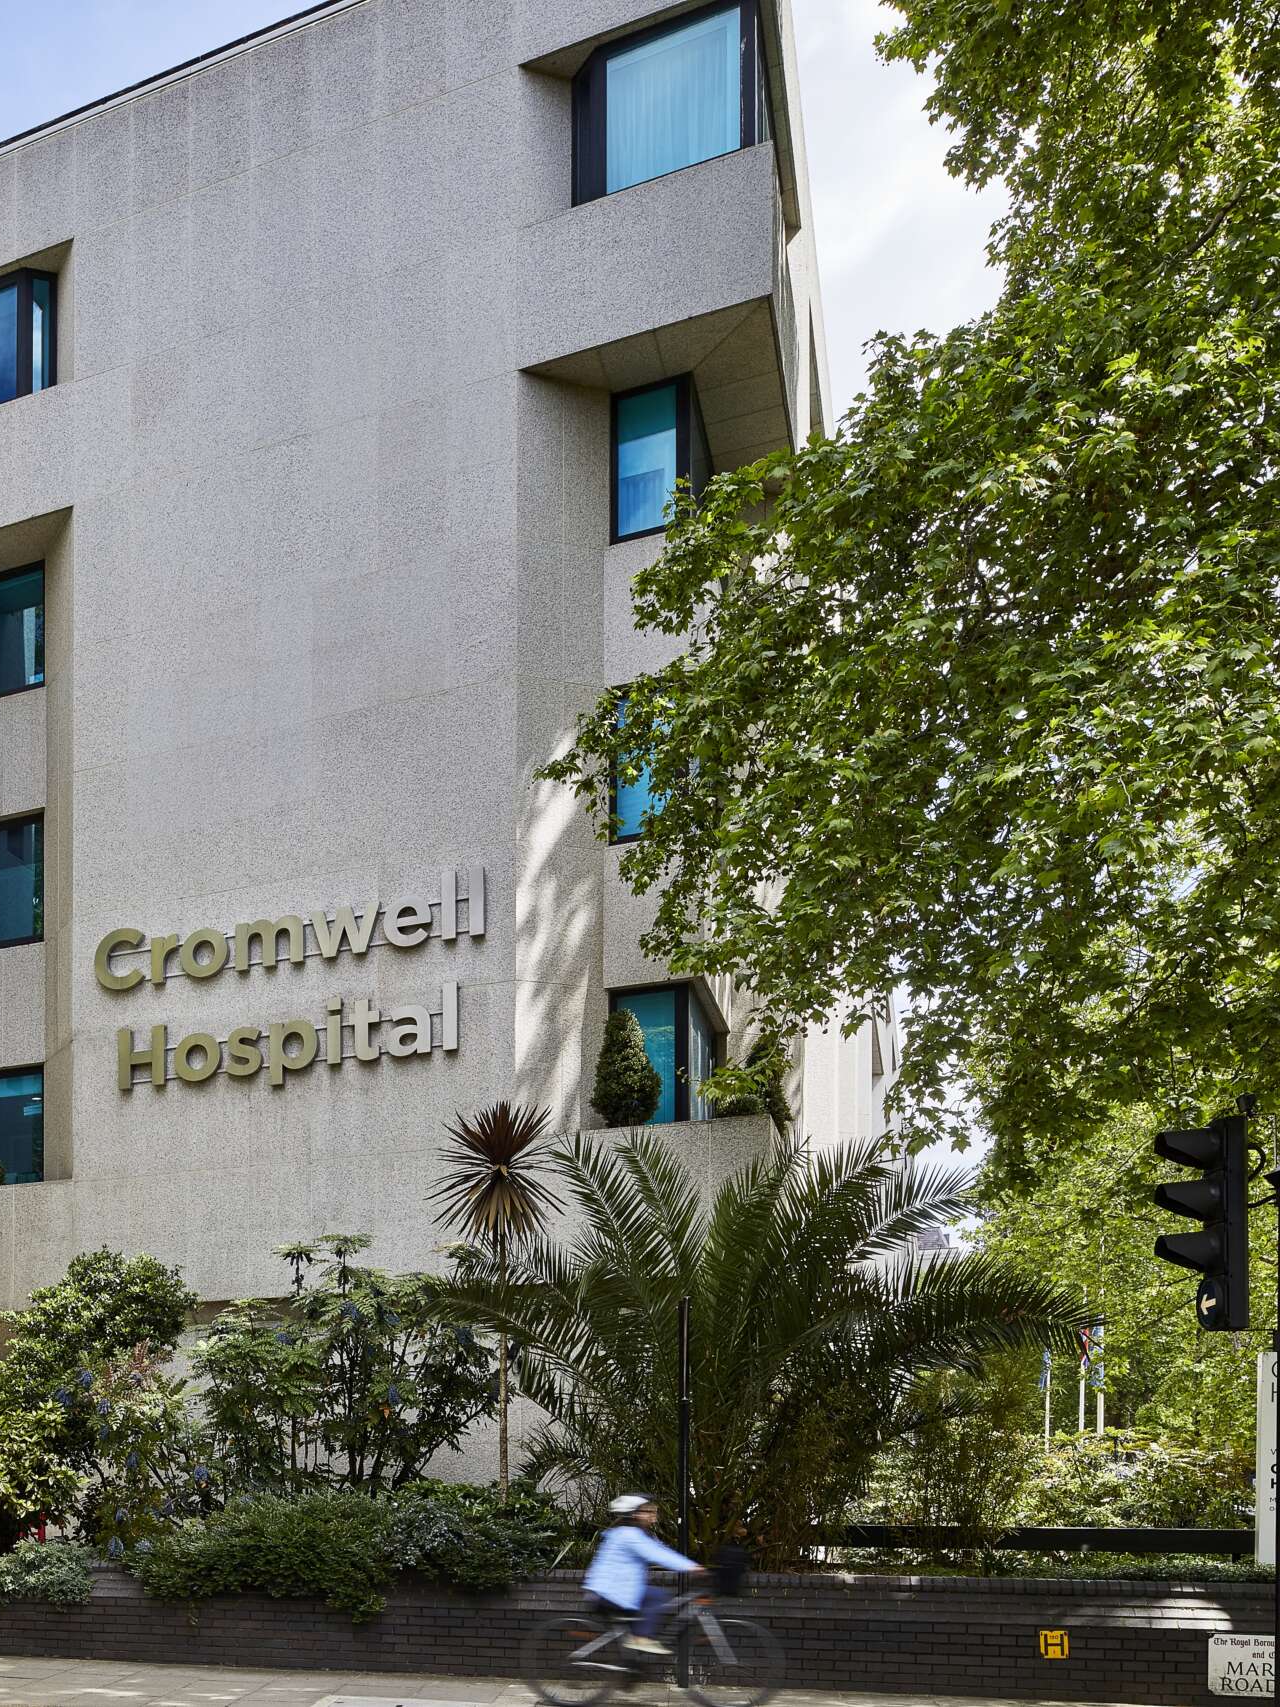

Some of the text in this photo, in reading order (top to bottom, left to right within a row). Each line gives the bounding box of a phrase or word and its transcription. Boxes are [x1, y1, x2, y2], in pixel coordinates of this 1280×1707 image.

[95, 865, 485, 990] Cromwell
[116, 981, 459, 1090] Hospital
[1044, 1633, 1065, 1656] H
[1214, 1638, 1228, 1646] The
[1230, 1638, 1251, 1648] Royal
[1227, 1661, 1275, 1676] MAR
